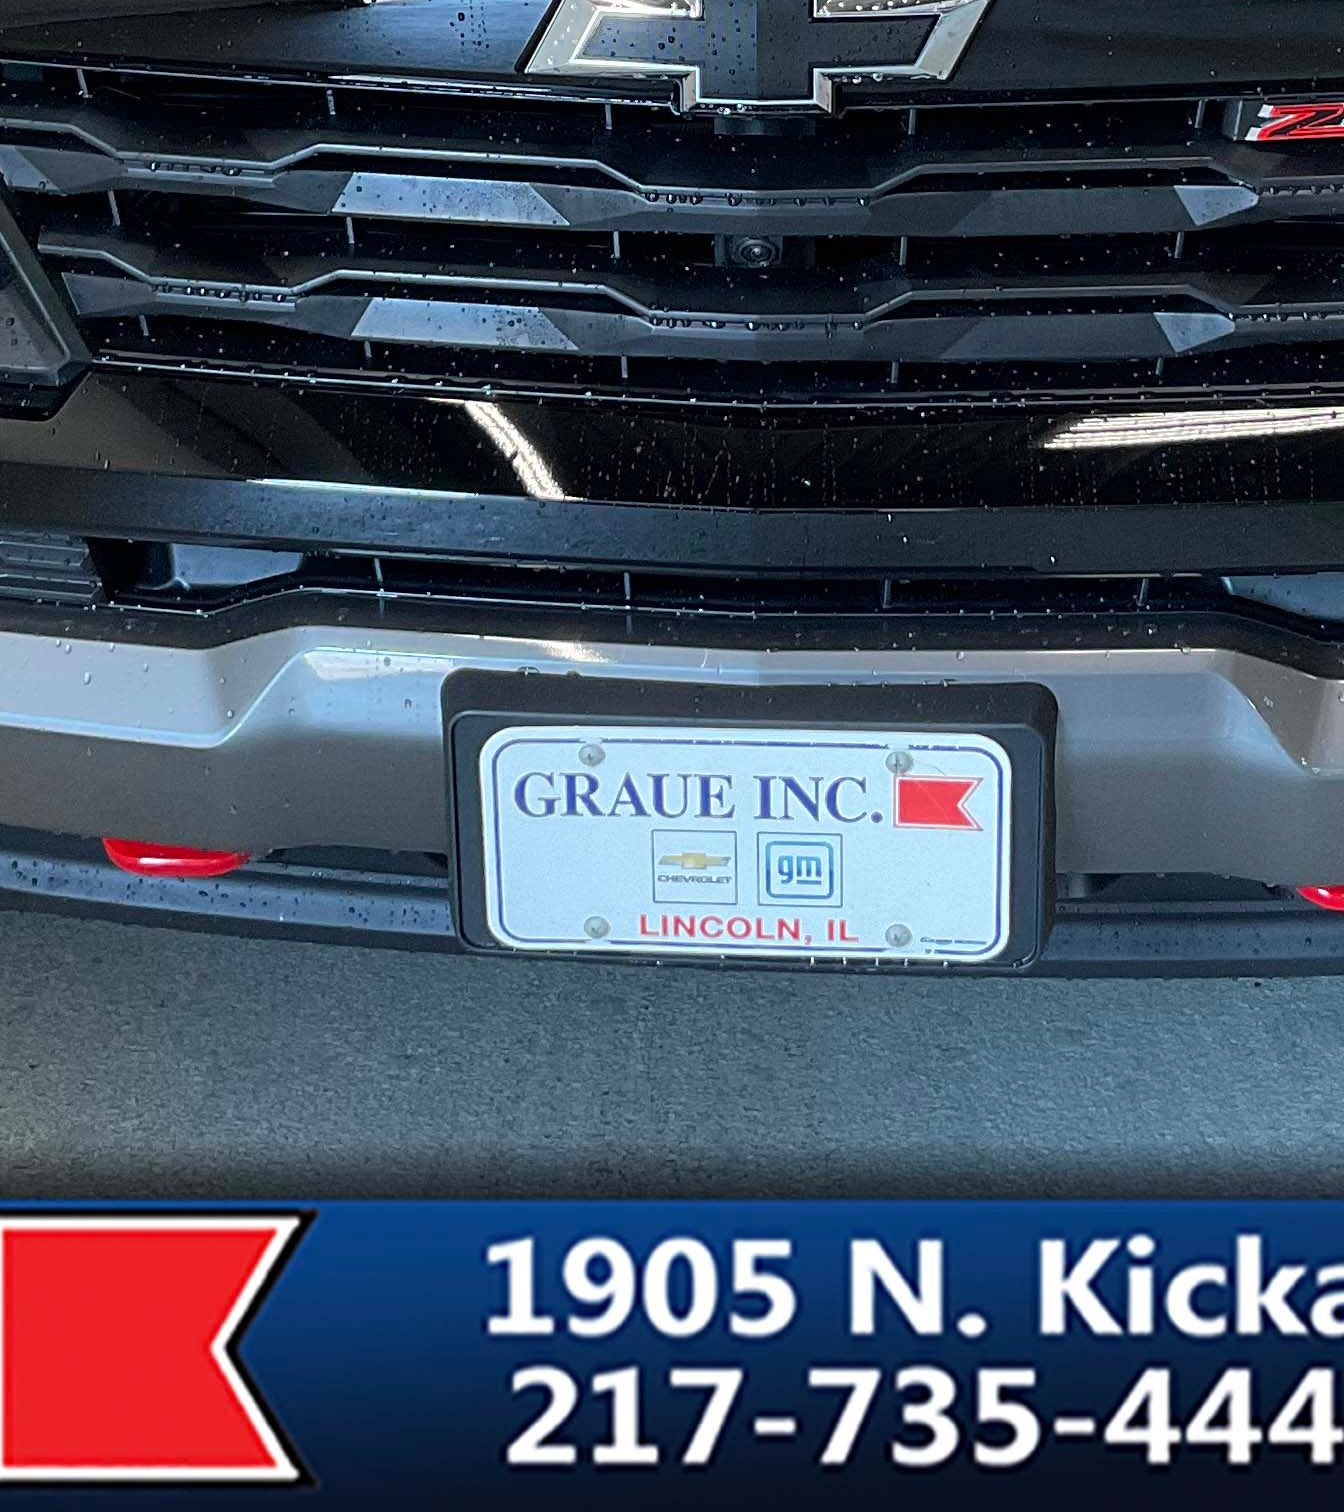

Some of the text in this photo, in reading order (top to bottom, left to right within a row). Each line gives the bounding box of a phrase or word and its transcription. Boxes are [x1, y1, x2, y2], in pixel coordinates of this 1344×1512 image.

[513, 770, 883, 824] GRAUE INC.
[657, 874, 733, 885] CHEVROLET
[777, 854, 823, 885] gm
[637, 914, 860, 945] LINCOLN, IL
